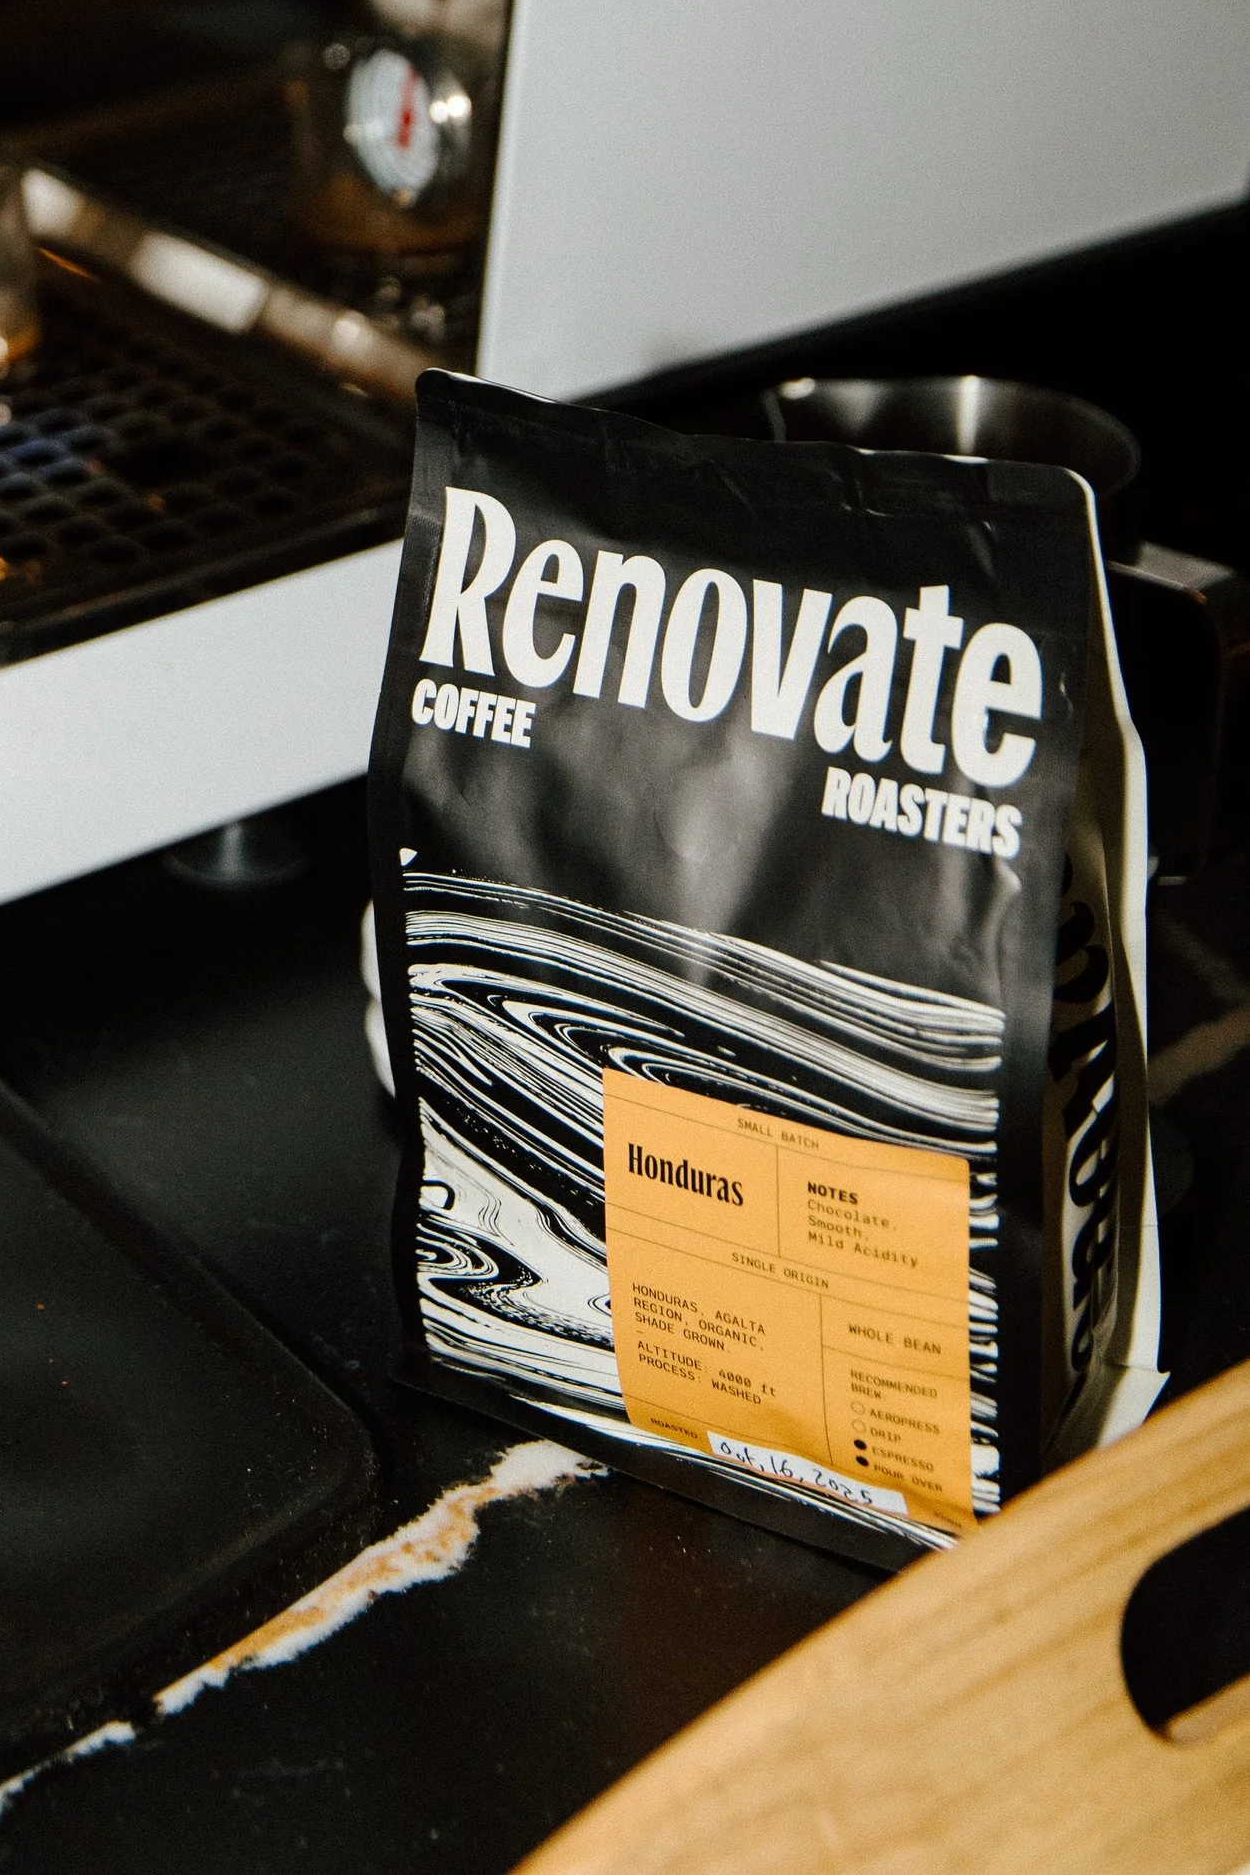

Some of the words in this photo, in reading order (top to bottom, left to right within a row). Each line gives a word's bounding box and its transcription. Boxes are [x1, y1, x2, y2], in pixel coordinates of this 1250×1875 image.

[419, 486, 1044, 787] Renovate
[412, 679, 537, 749] COFFEE
[821, 766, 1023, 860] ROASTERS
[737, 1118, 773, 1137] SMALL
[781, 1132, 819, 1149] BATCH
[628, 1142, 744, 1207] Honduras
[807, 1181, 858, 1205] NOTES
[808, 1231, 844, 1250] Mild
[854, 1242, 918, 1268] Acidity
[732, 1252, 776, 1274] SINGLE
[783, 1268, 829, 1289] ORIGIN
[635, 1312, 675, 1334] SHADE
[715, 1310, 765, 1335] AGALTA
[849, 1323, 894, 1343] WHOLE
[904, 1337, 942, 1355] BEAN
[711, 1379, 761, 1404] WASHED
[719, 1368, 752, 1388] 4000
[761, 1383, 776, 1398] ft
[850, 1369, 938, 1399] RECOMMENDED
[851, 1383, 882, 1399] BREW
[870, 1408, 941, 1435] AEROPRESS
[870, 1426, 902, 1443] DRIP
[872, 1446, 934, 1472] ESPRESSO
[873, 1464, 905, 1481] POUR
[912, 1477, 943, 1493] OVER
